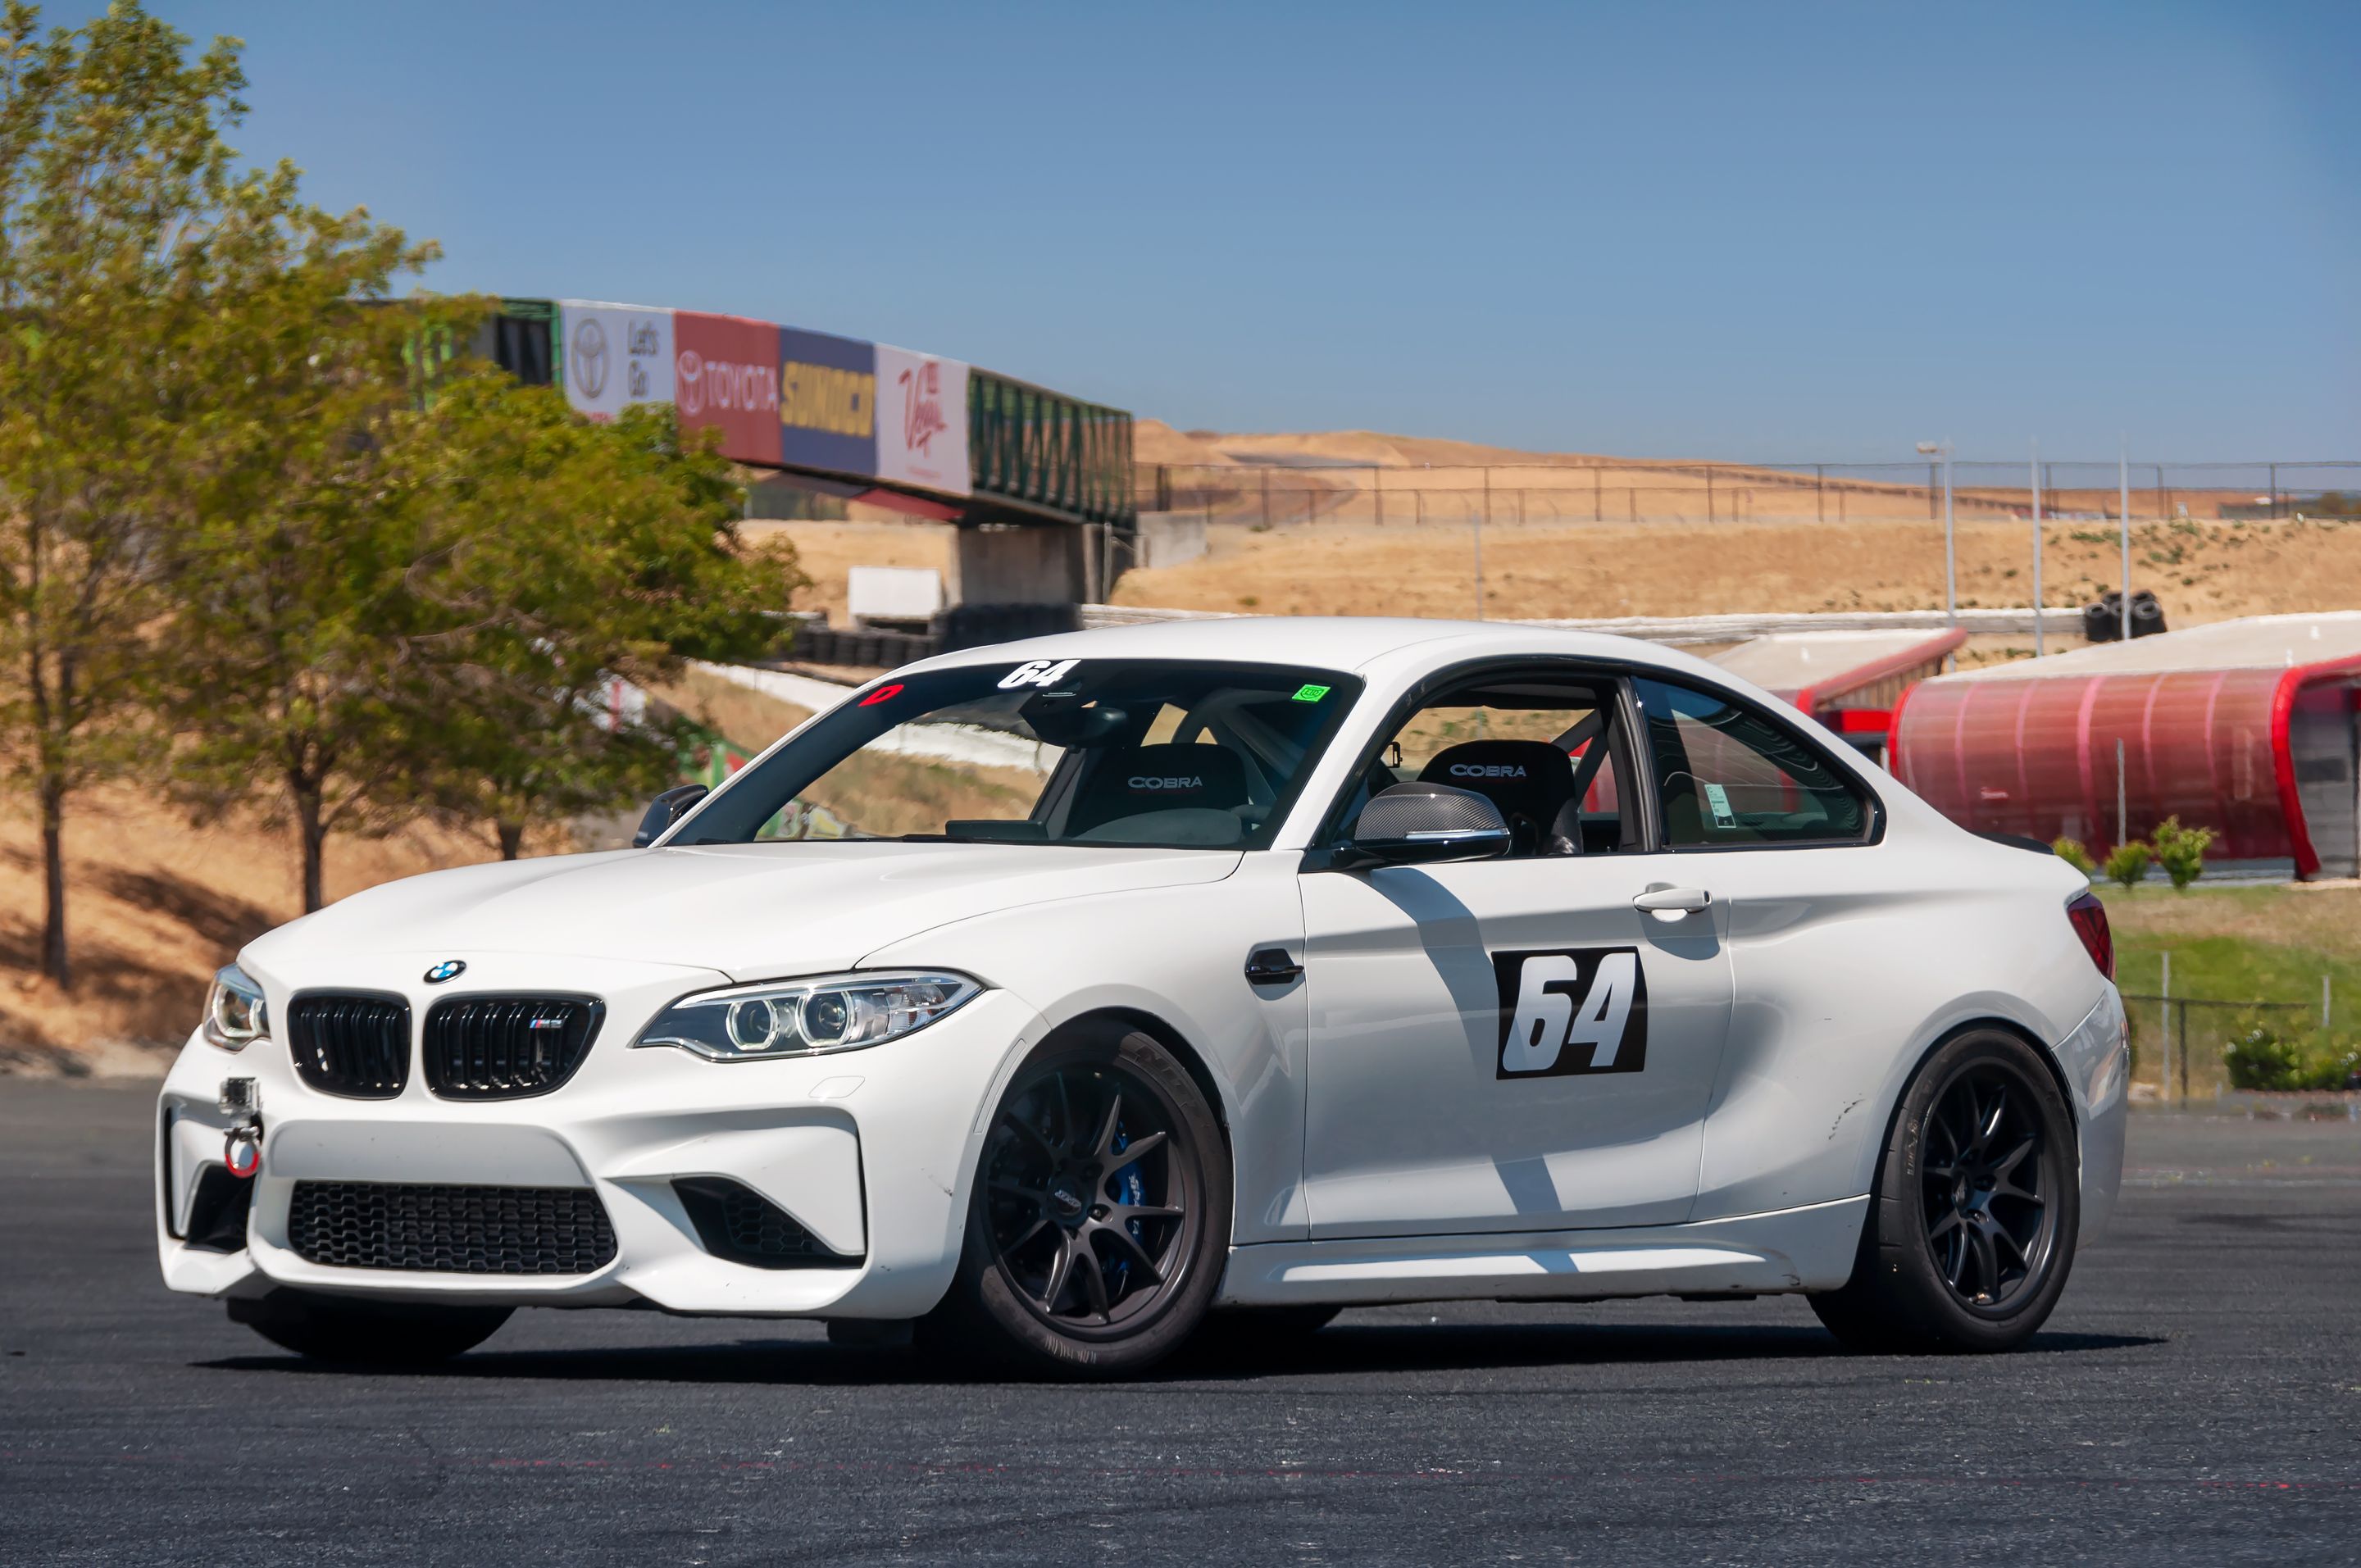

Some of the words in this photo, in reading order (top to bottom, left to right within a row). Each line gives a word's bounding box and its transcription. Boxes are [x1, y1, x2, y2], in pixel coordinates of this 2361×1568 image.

[705, 361, 778, 411] TOYOTA
[782, 361, 876, 438] SUNOCO
[997, 659, 1081, 689] 64
[1128, 776, 1203, 789] COBRA
[1450, 764, 1526, 777] COBRA
[1502, 952, 1636, 1072] 64
